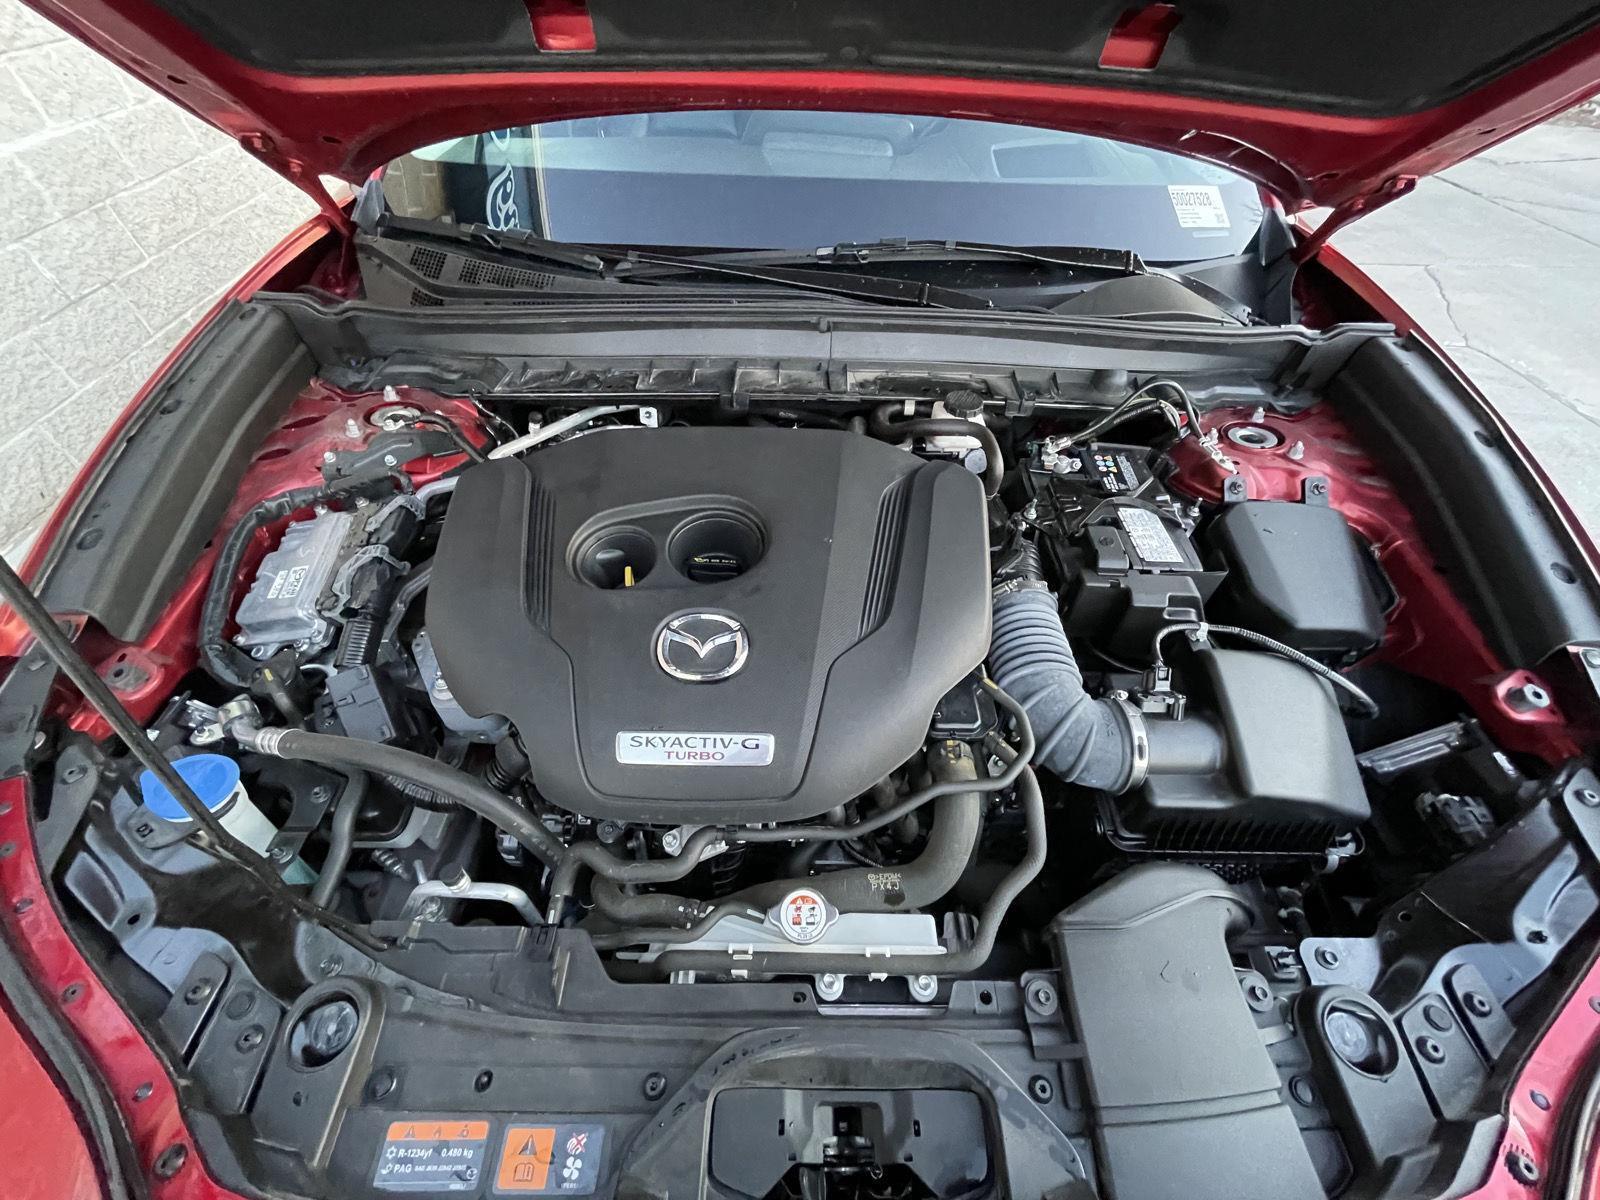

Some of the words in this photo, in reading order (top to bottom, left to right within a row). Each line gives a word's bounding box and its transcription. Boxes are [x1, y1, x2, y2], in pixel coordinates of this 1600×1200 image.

[630, 735, 760, 750] SKYACTIV-G
[664, 751, 725, 761] TURBO
[397, 1148, 433, 1160] R-1234yf
[463, 1148, 474, 1159] kg
[393, 1164, 412, 1174] PAG
